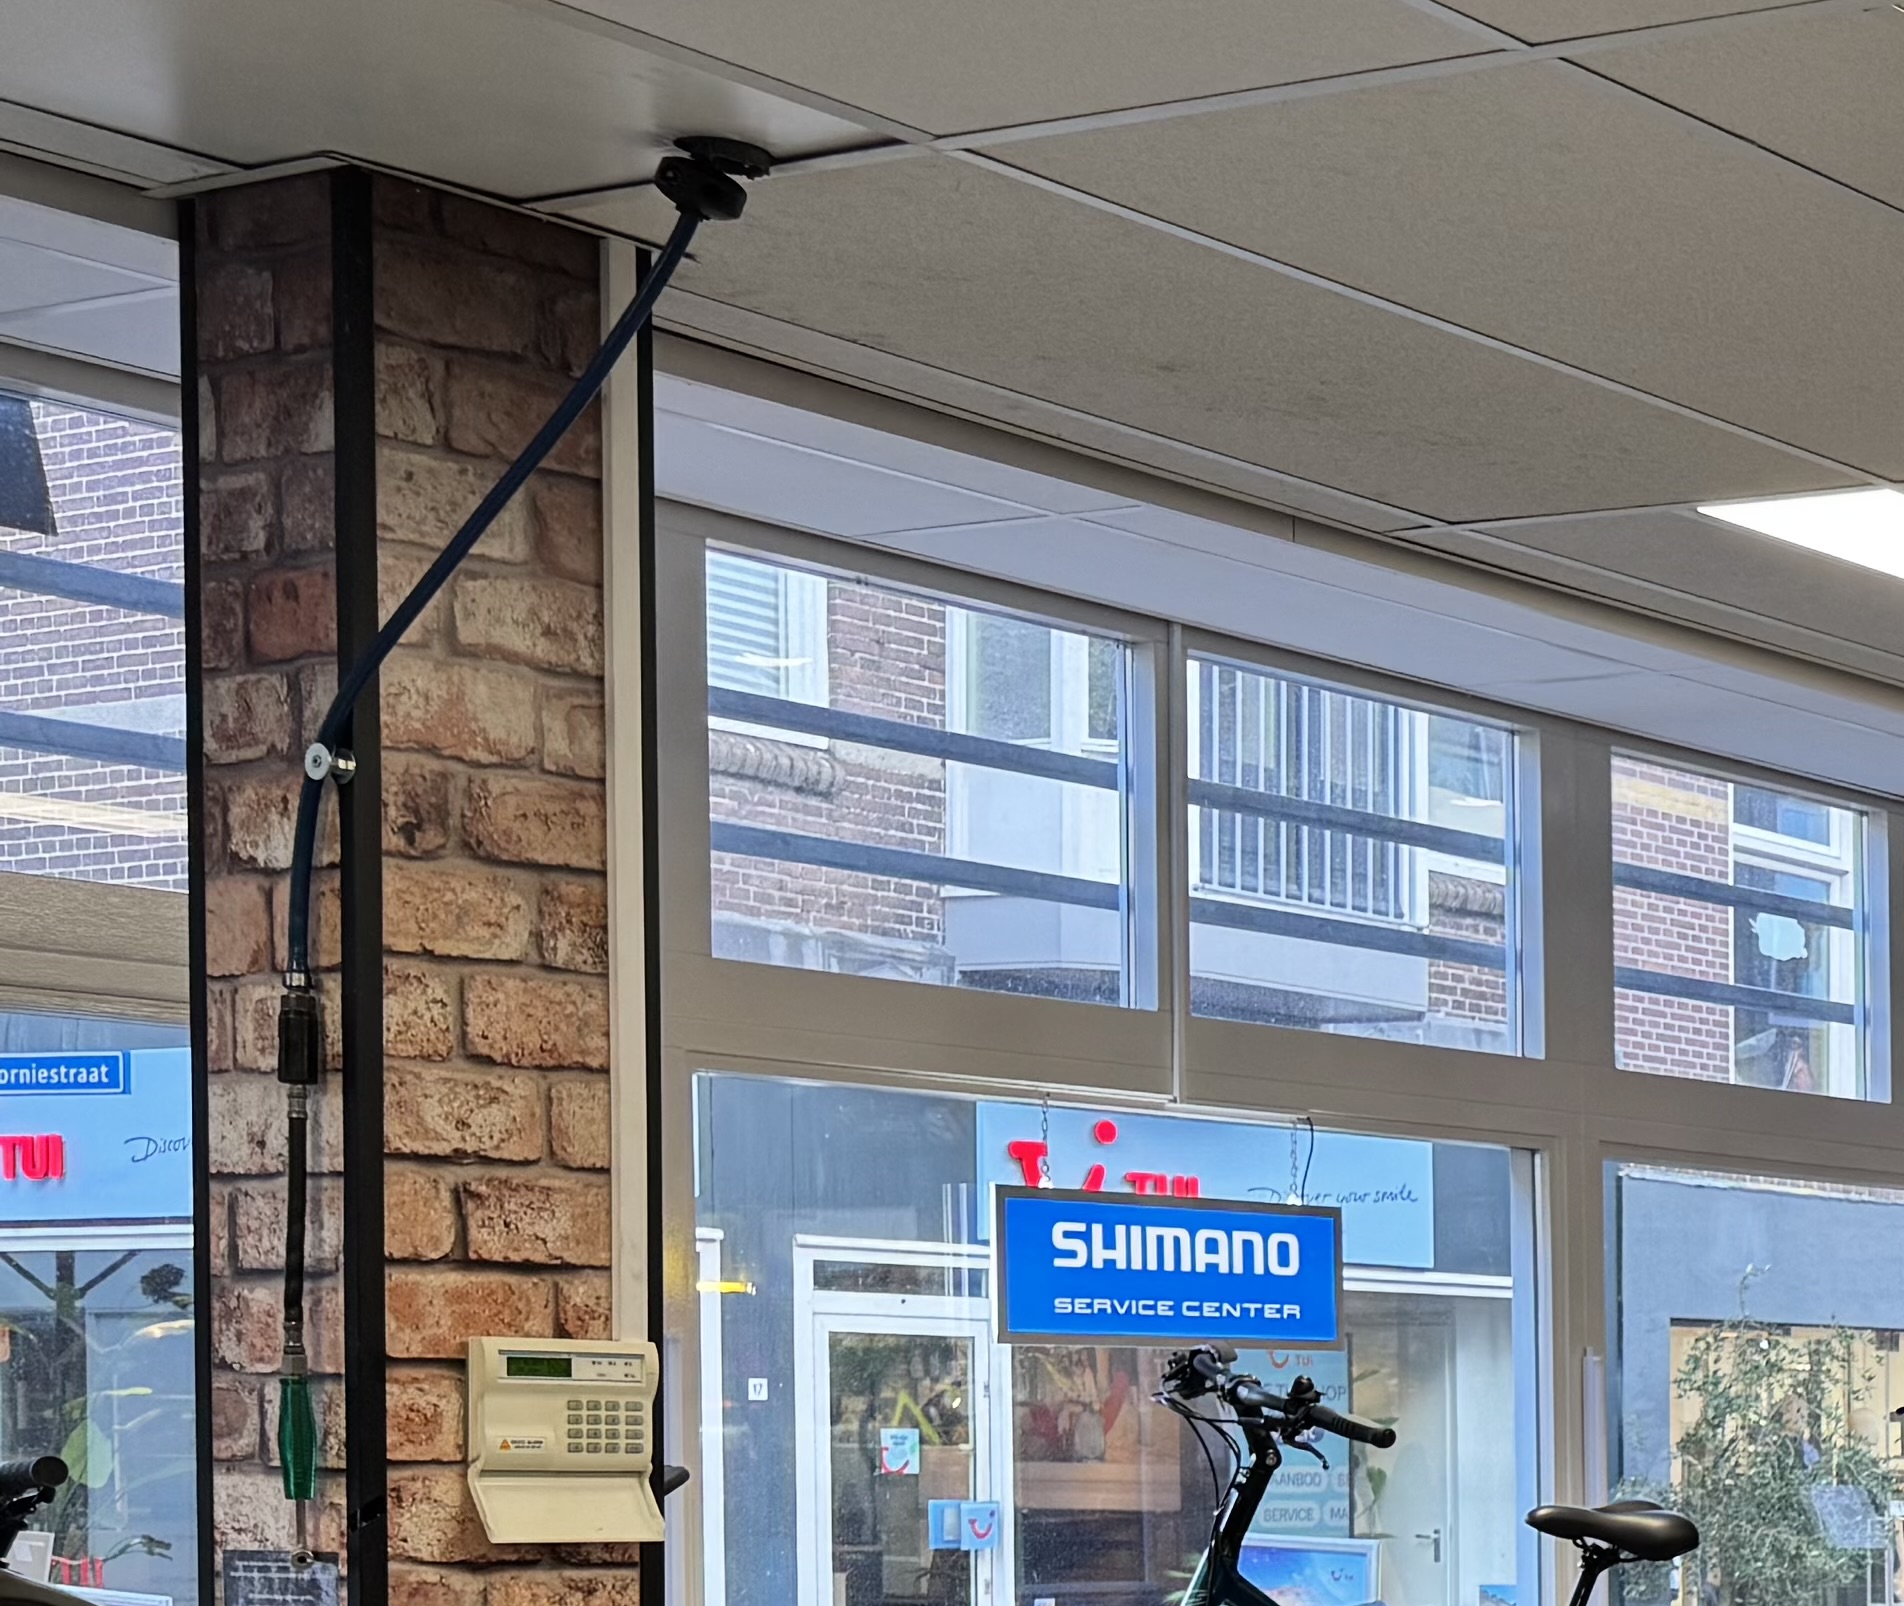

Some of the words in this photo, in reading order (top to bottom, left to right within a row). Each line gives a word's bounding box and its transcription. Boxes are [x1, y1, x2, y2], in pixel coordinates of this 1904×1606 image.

[123, 1136, 191, 1163] Discov
[1372, 1183, 1419, 1203] smile
[1051, 1221, 1300, 1276] SHIMANO
[1054, 1297, 1175, 1317] SERVICE
[1181, 1302, 1301, 1321] CENTER
[1263, 1508, 1315, 1522] SERVICE
